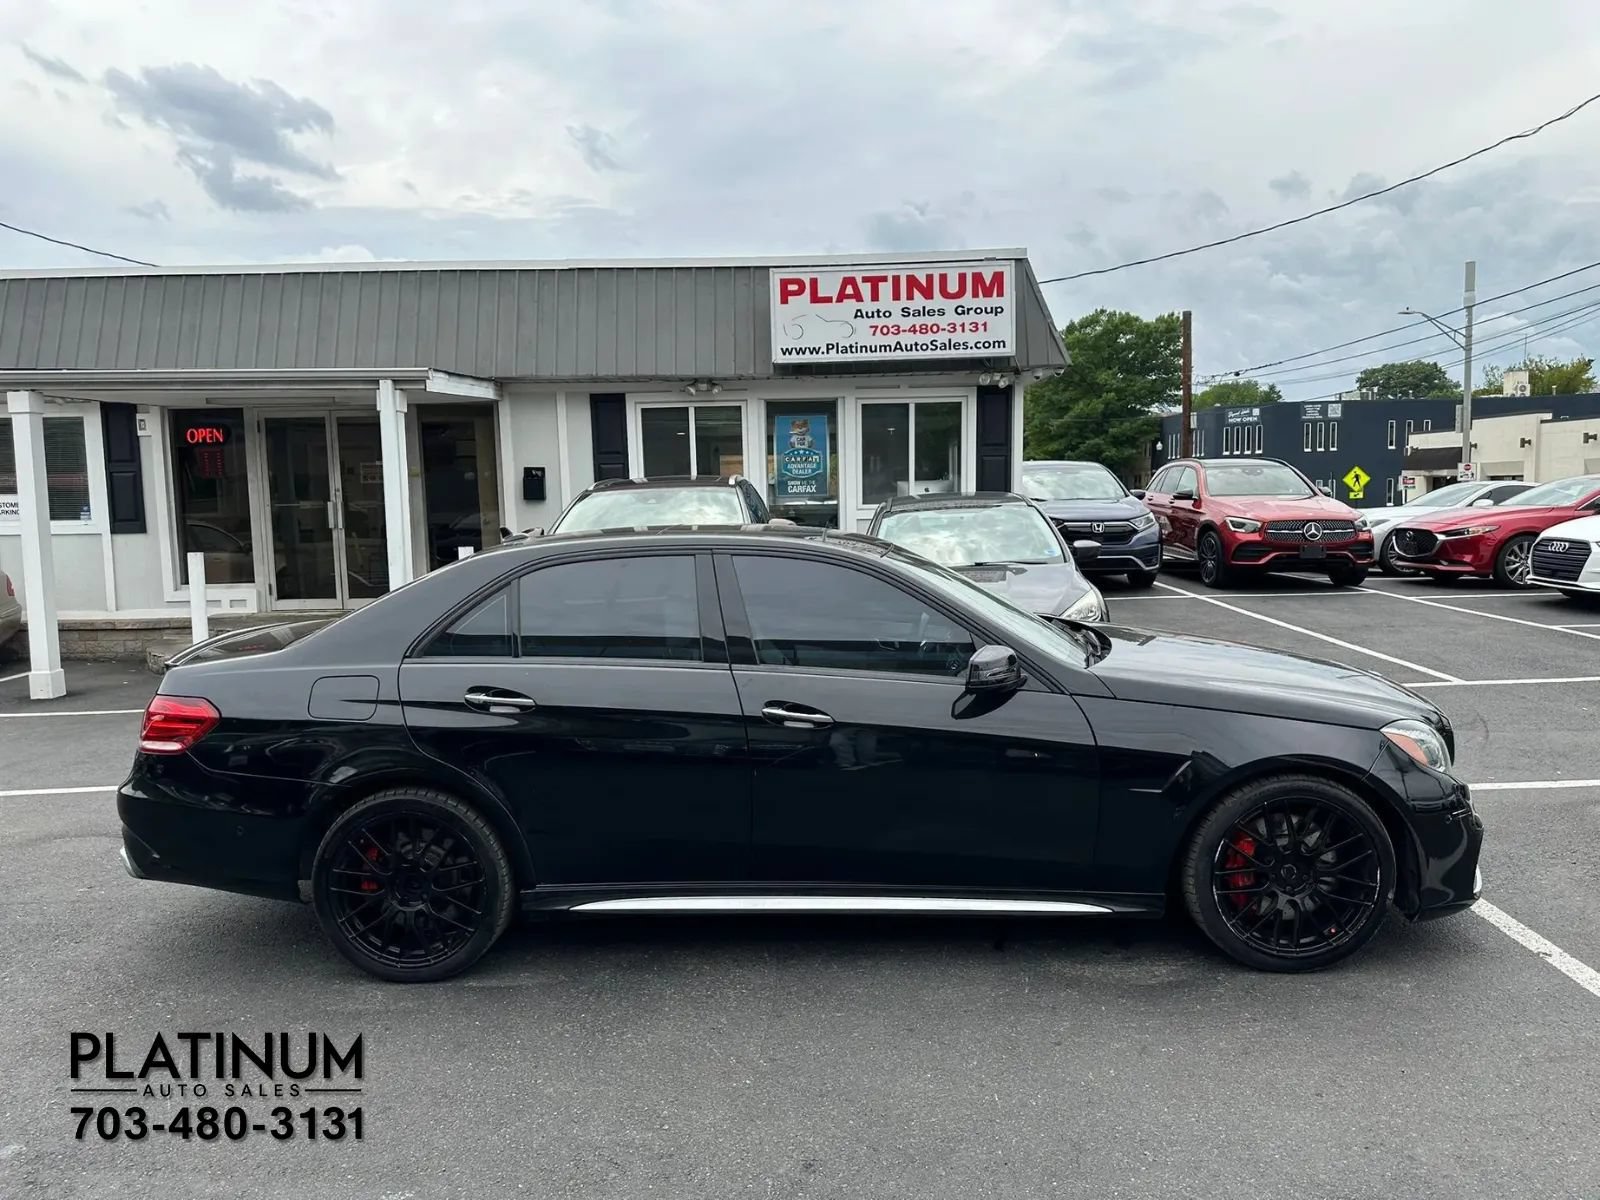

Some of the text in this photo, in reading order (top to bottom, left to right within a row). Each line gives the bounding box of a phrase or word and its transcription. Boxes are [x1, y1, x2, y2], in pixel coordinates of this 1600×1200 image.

[779, 271, 1004, 305] PLATINUM
[853, 304, 1004, 319] Auto Sales Group
[869, 321, 988, 336] 703-480-3131
[780, 338, 1006, 356] www.PlatinumAutoSales.com
[186, 428, 224, 444] OPEN
[788, 485, 817, 493] CARFAX
